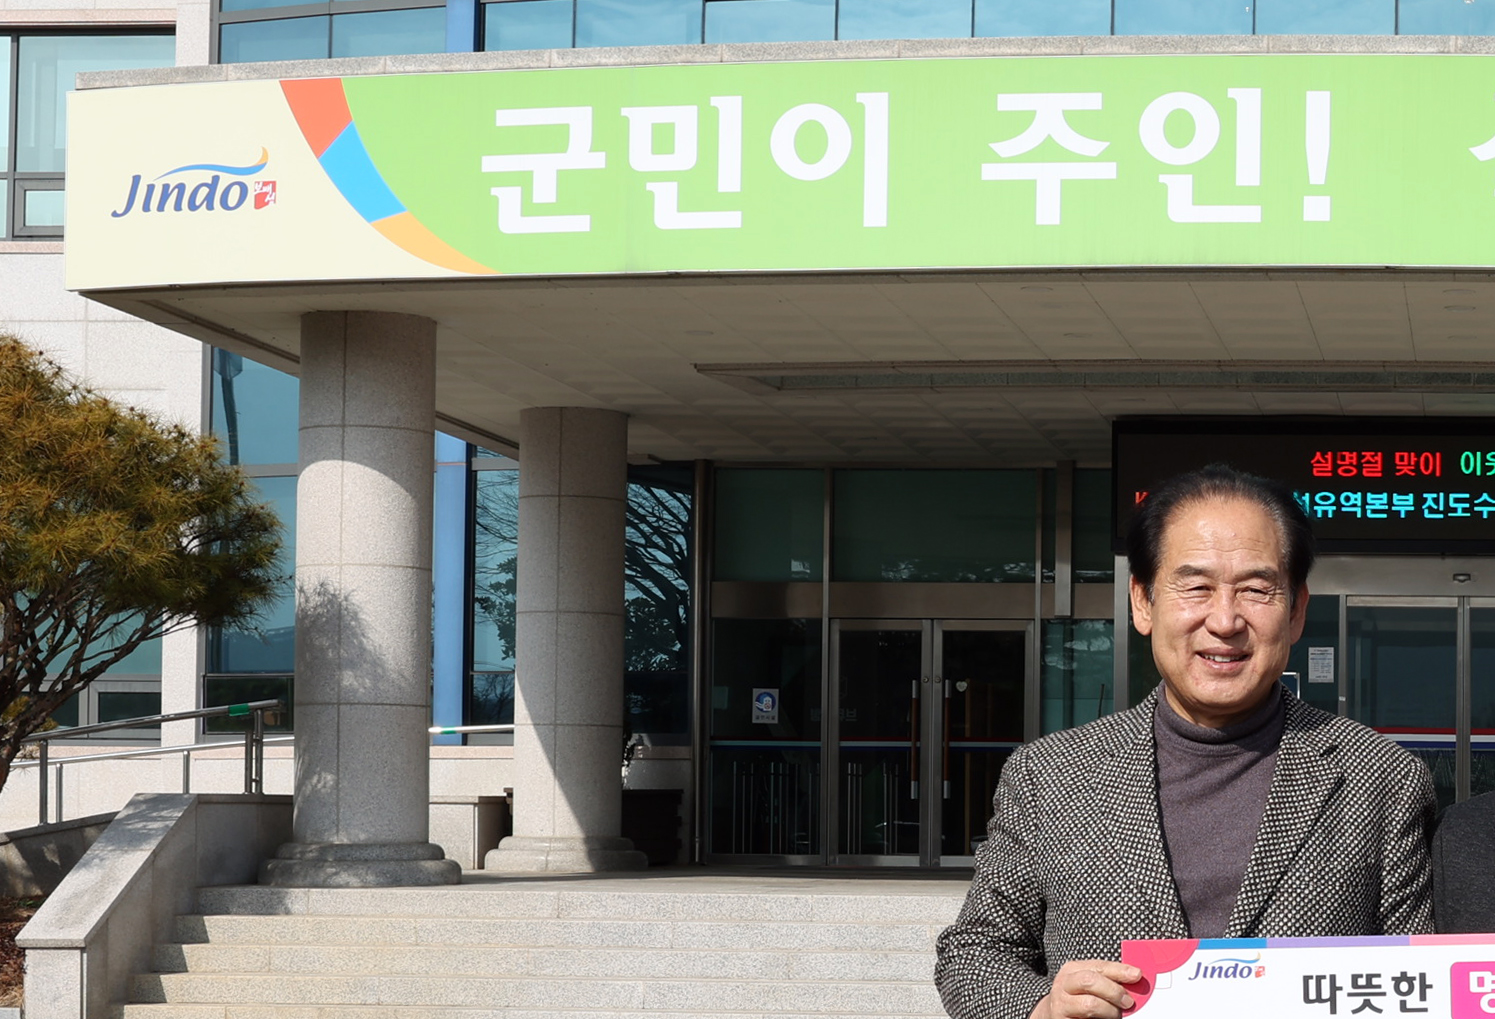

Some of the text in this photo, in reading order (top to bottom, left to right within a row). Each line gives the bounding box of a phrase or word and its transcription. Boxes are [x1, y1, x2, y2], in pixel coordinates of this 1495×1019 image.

[480, 92, 890, 235] 군민이
[981, 87, 1331, 227] 주인!
[110, 173, 250, 219] Jindo
[1310, 450, 1384, 478] 설명절
[1394, 450, 1442, 478] 맞이
[1188, 961, 1253, 981] Jindo
[1302, 970, 1434, 1015] 따뜻한
